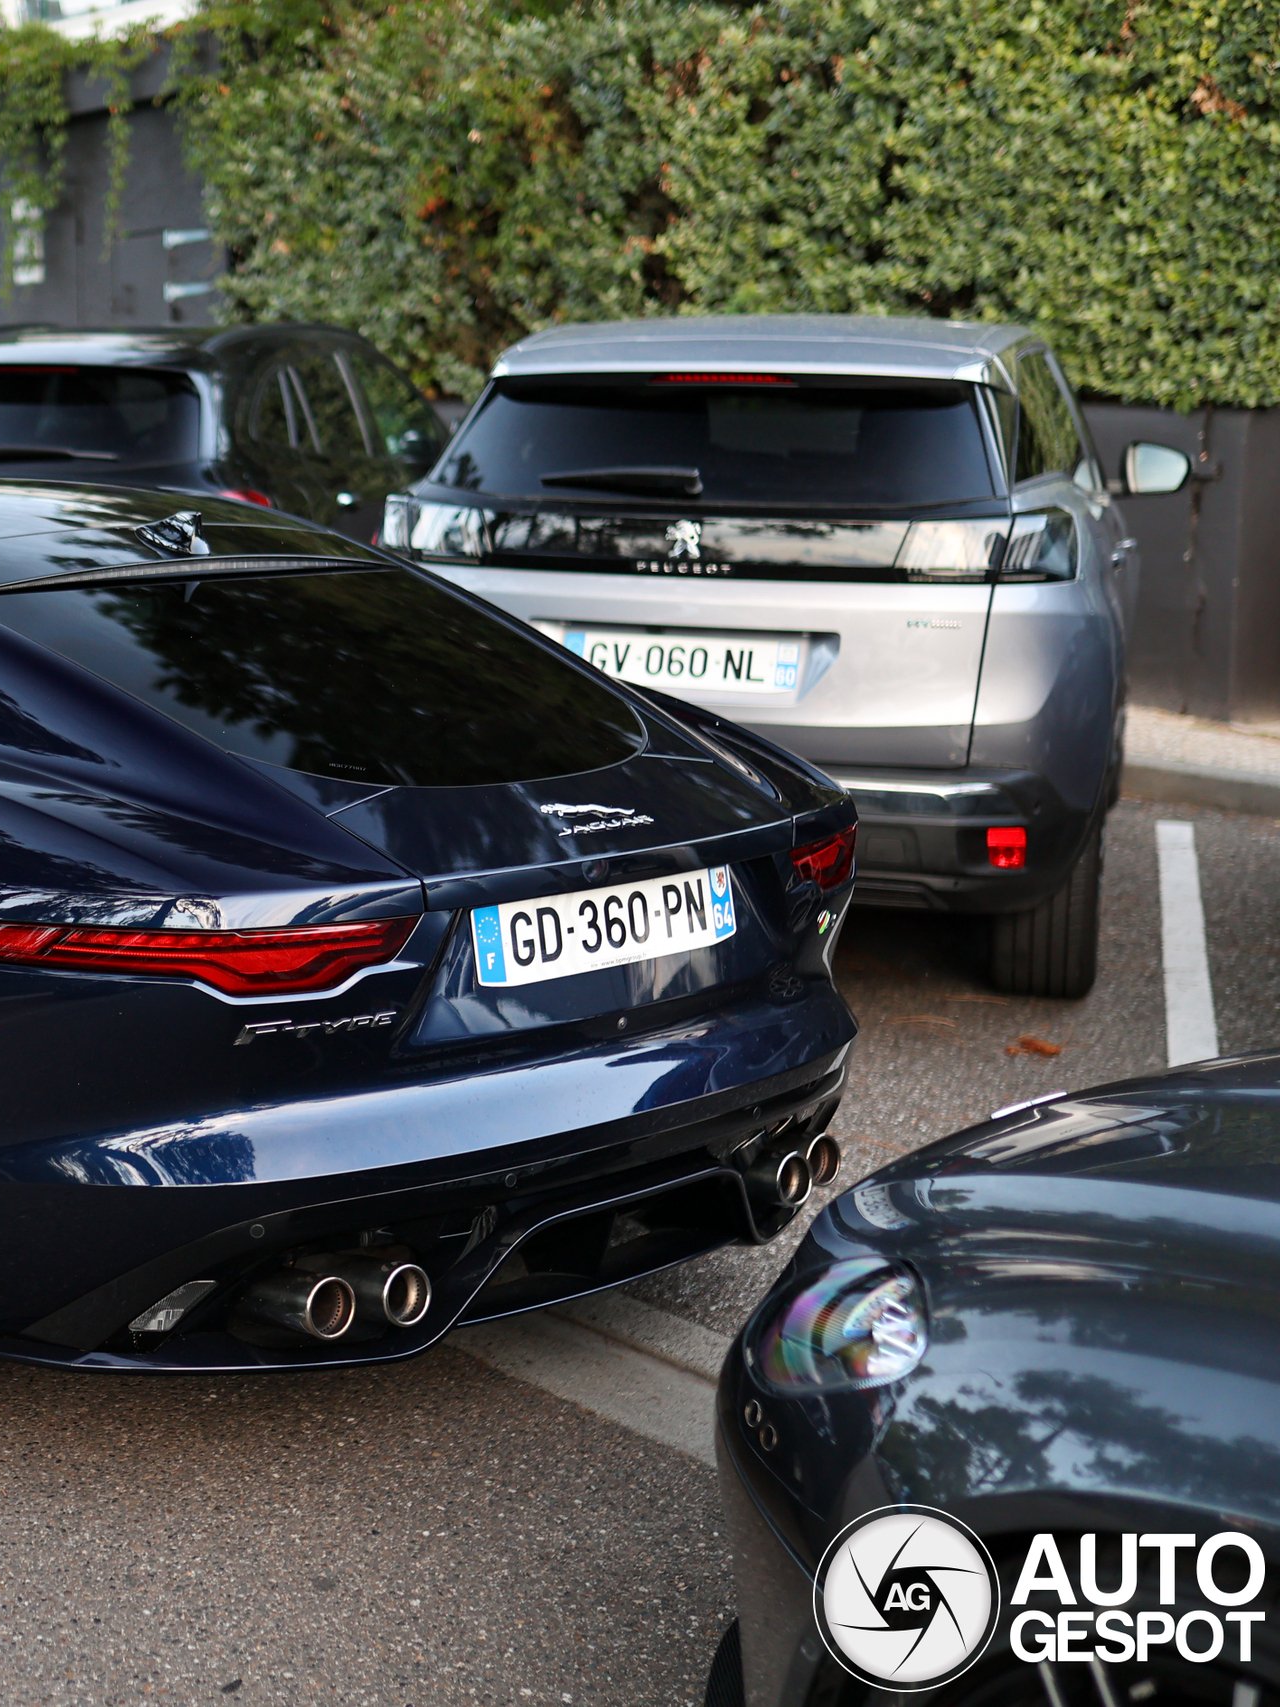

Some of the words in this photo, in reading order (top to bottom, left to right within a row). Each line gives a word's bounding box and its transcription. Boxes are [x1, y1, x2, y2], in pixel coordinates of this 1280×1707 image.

[636, 561, 731, 574] PEUGEOT
[590, 642, 764, 682] GV-060-NL
[775, 666, 796, 686] 60
[559, 814, 654, 836] JAGUAR
[509, 878, 707, 966] GD-360-PN
[713, 900, 732, 929] 64
[486, 952, 496, 970] F
[233, 1011, 397, 1046] F-TYPE
